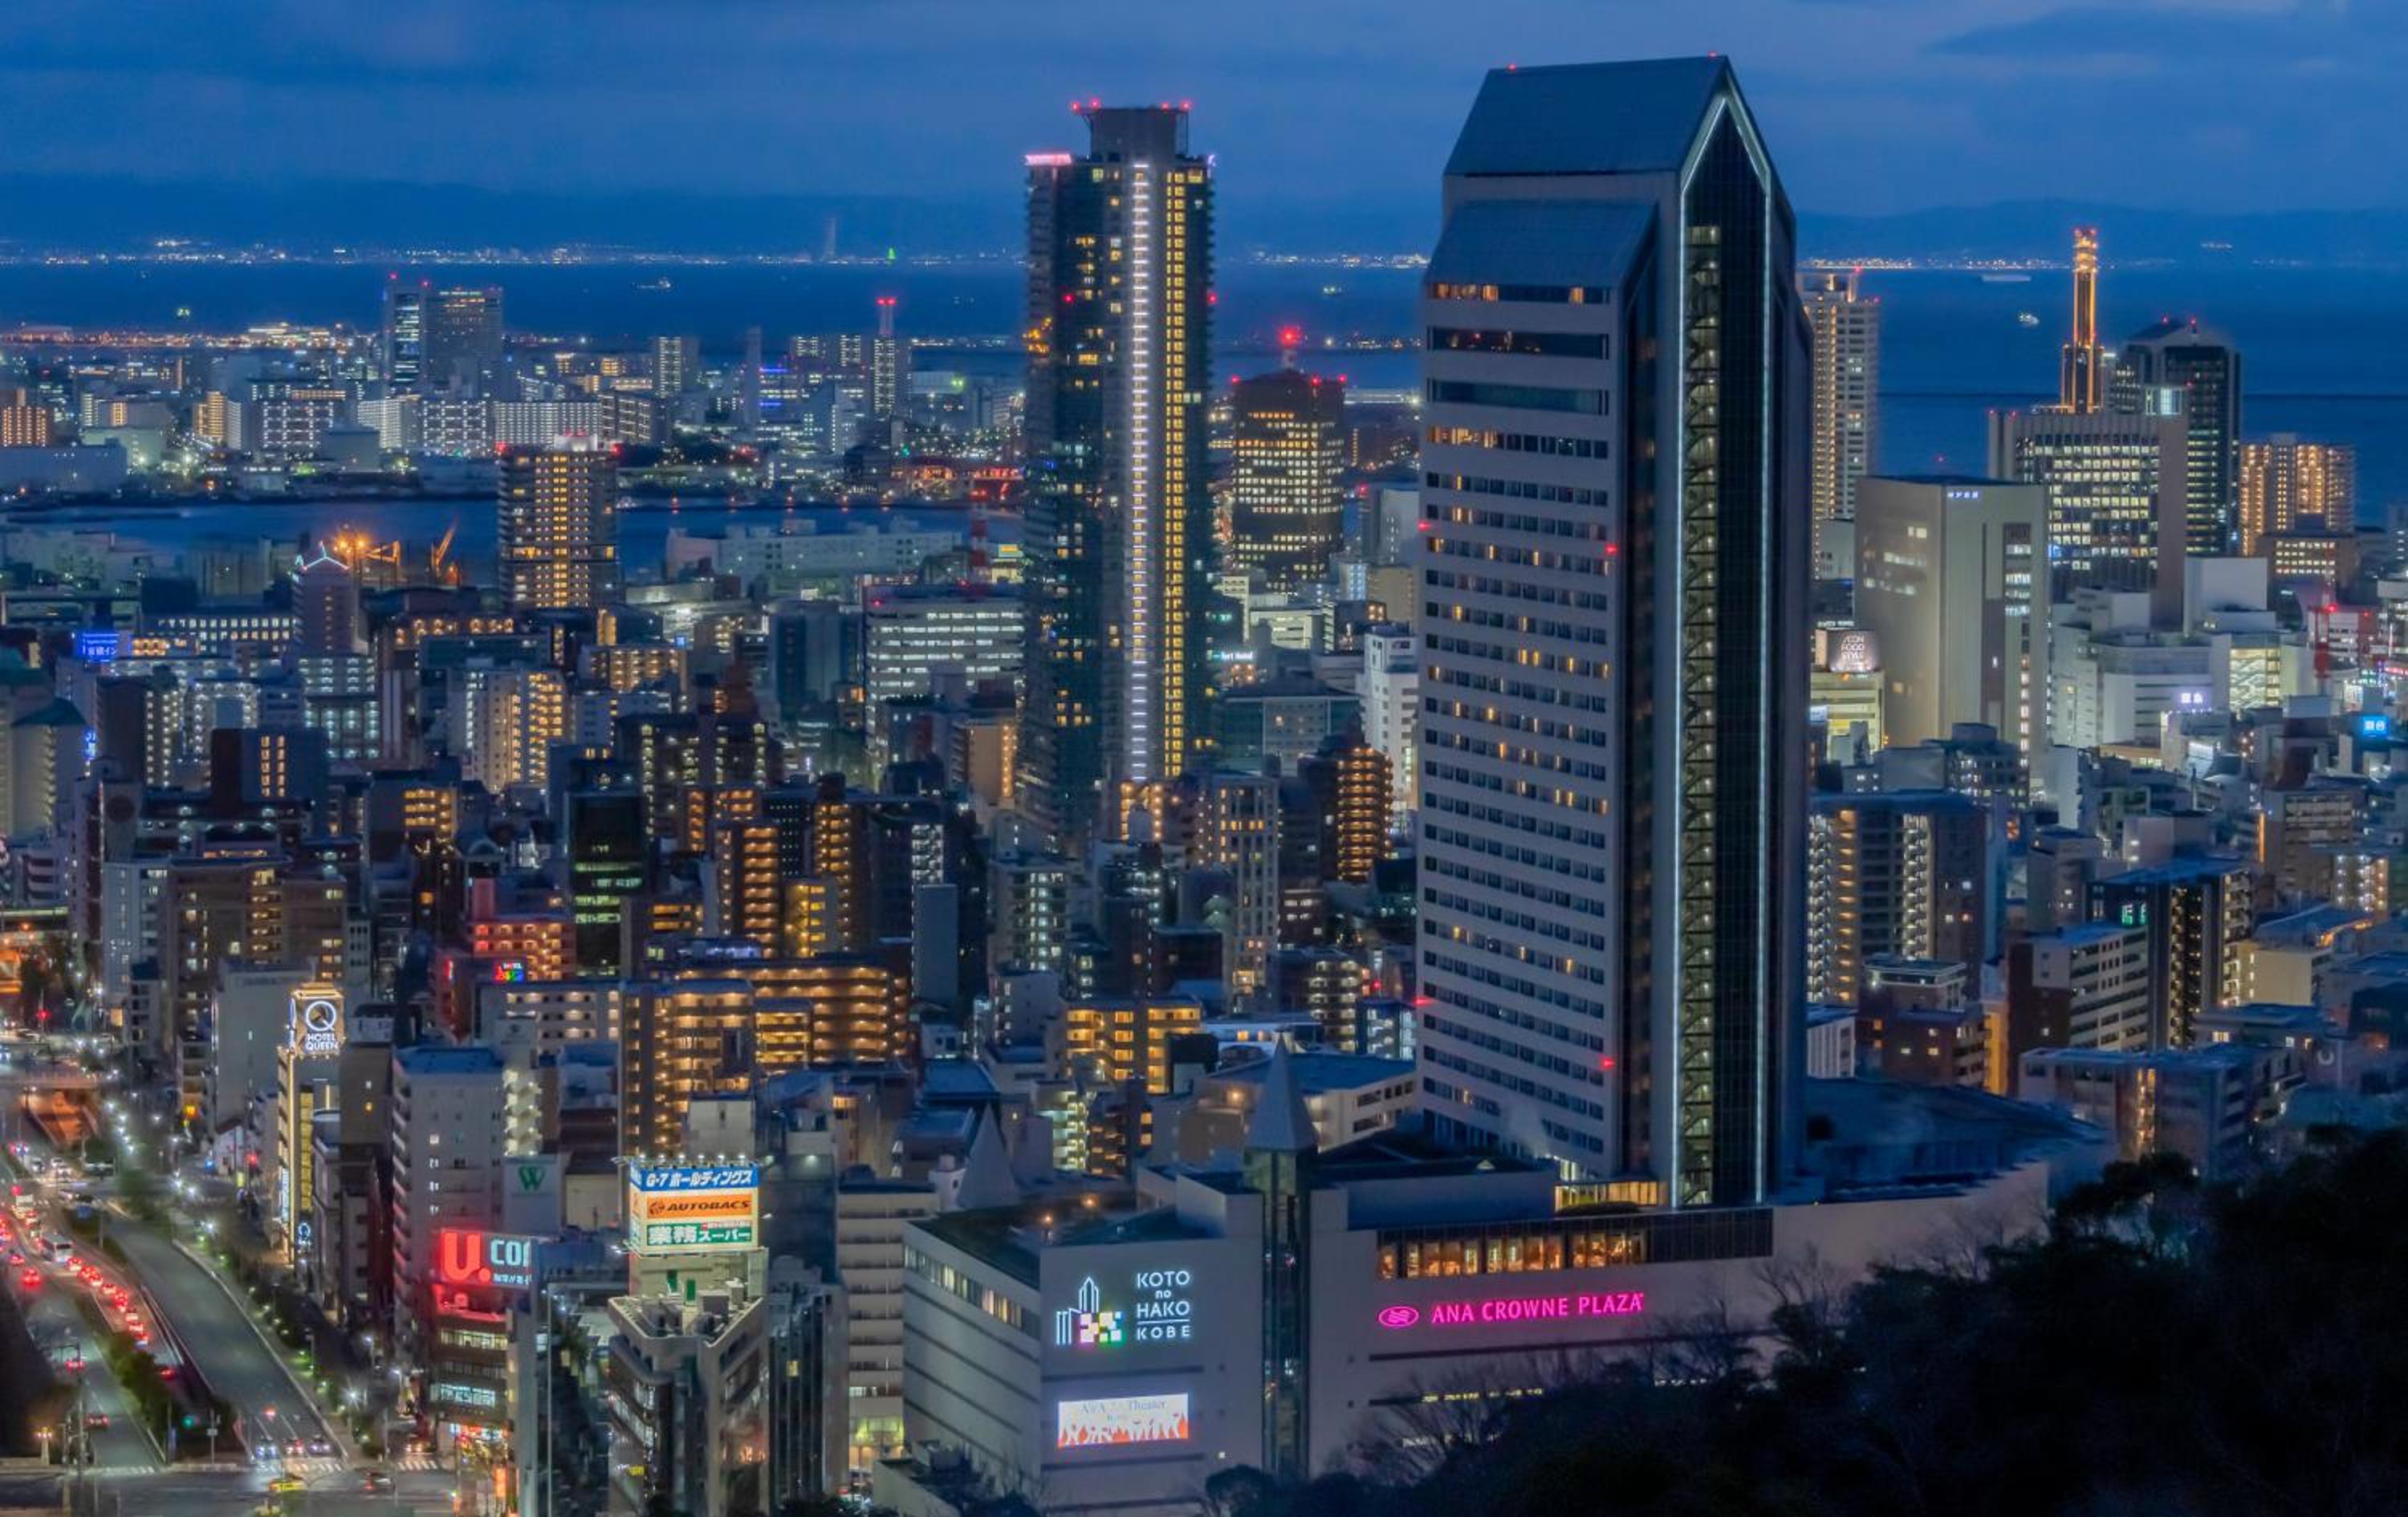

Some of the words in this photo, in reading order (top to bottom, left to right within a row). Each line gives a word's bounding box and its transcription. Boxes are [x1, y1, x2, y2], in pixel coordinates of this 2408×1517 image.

[306, 1001, 336, 1031] Q
[307, 1033, 335, 1042] HOTEL
[306, 1041, 339, 1051] QUEEN
[667, 1201, 751, 1212] AUTOBACS
[1137, 1271, 1190, 1288] KOTO
[1155, 1290, 1172, 1299] no
[1137, 1301, 1190, 1319] HAKO
[1431, 1305, 1474, 1324] ANA
[1482, 1297, 1568, 1320] CROWNE
[1577, 1292, 1644, 1314] PLAZA
[1137, 1325, 1191, 1340] KOBE
